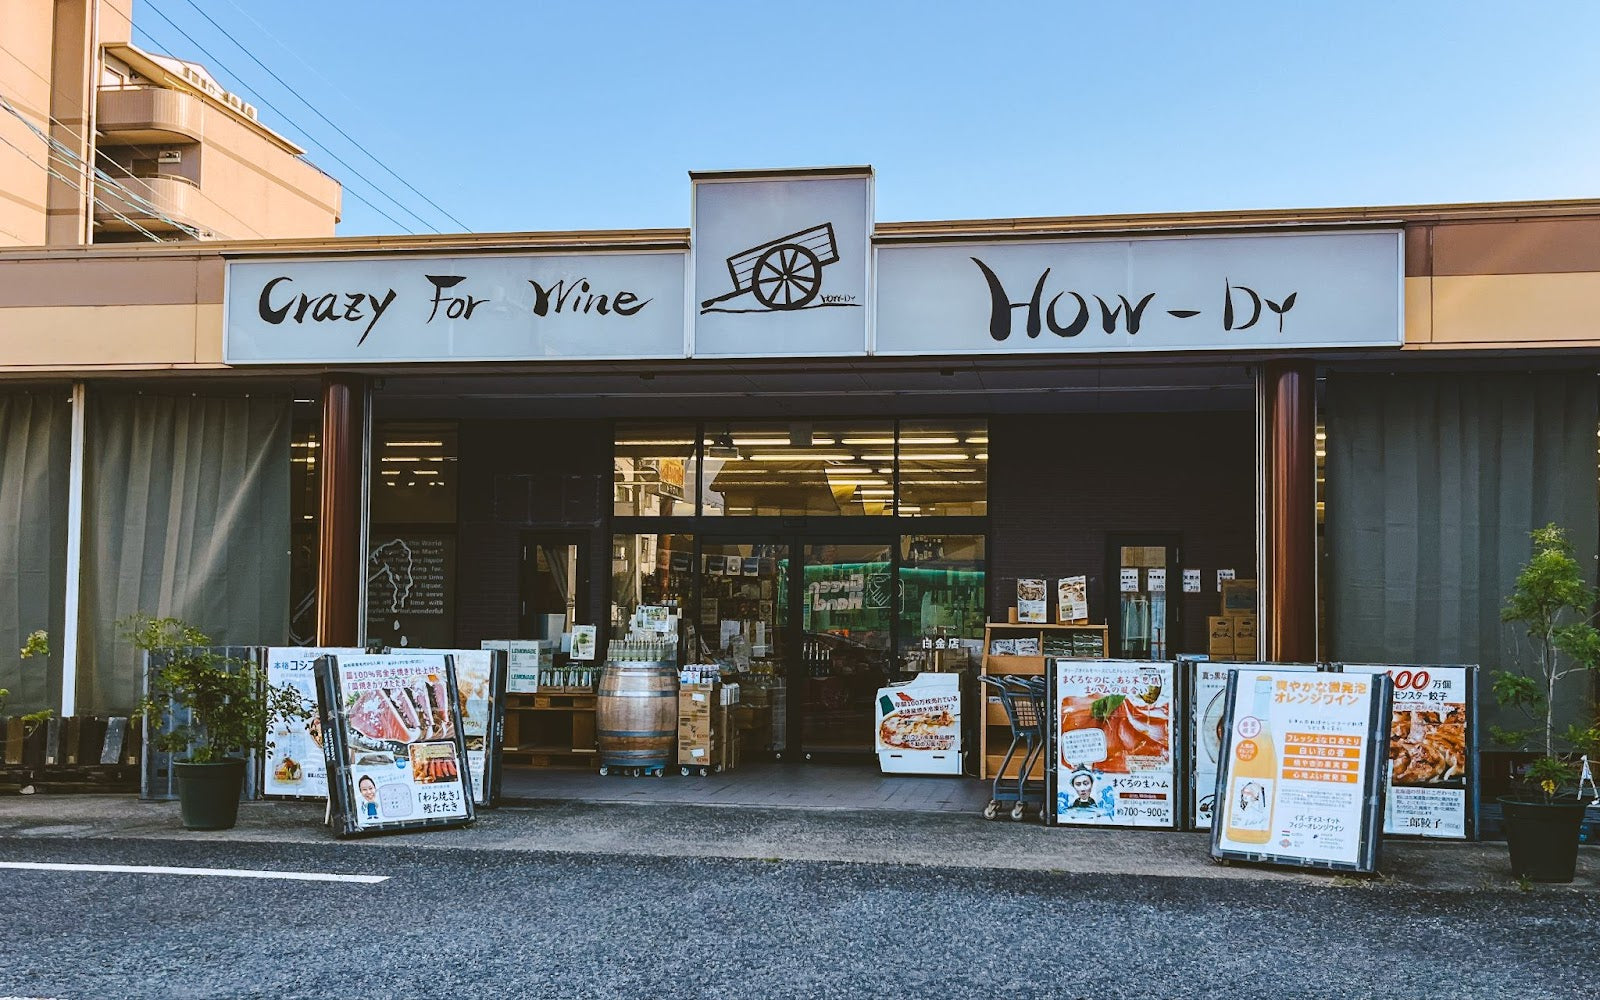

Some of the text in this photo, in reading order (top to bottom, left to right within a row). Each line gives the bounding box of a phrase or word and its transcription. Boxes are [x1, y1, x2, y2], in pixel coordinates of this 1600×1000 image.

[258, 274, 654, 346] Crazy For Wine
[922, 636, 960, 649] 白金店
[1433, 680, 1452, 689] 万個
[1274, 692, 1359, 705] オレンジワイン
[1287, 734, 1360, 746] フレッシュな口あたり
[1112, 778, 1169, 789] まぐろの生ハム
[1398, 816, 1443, 829] 三郎餃子
